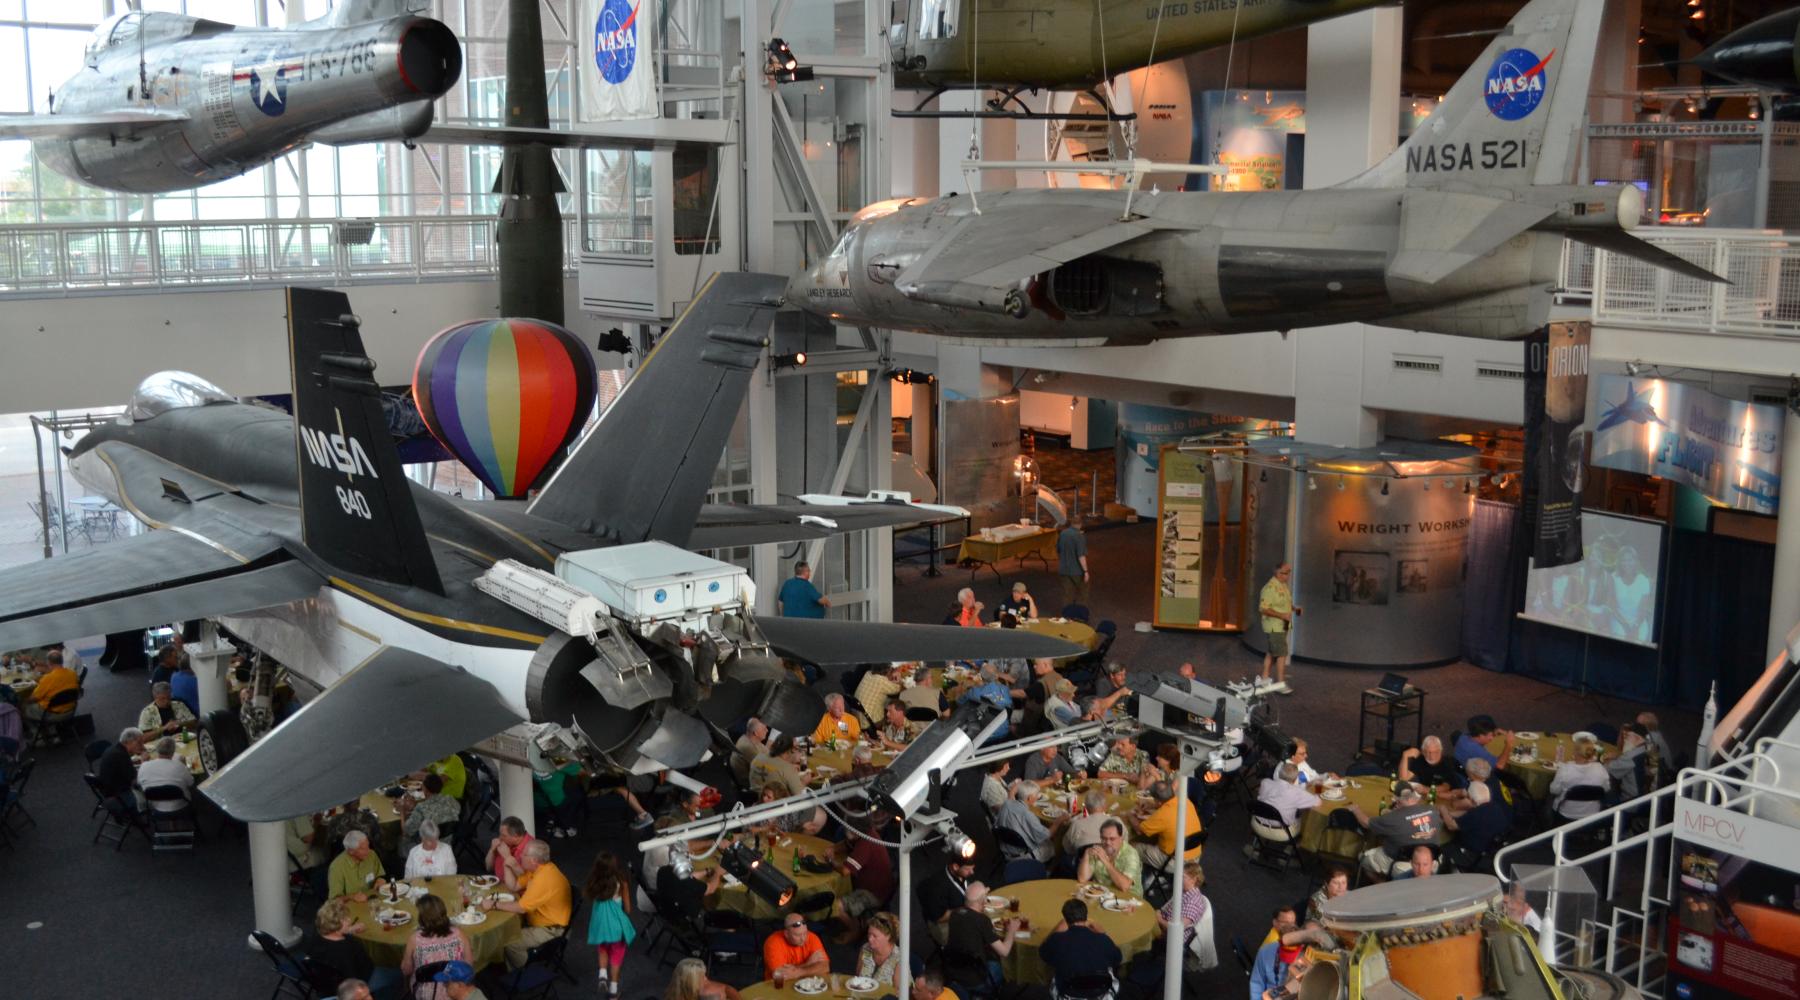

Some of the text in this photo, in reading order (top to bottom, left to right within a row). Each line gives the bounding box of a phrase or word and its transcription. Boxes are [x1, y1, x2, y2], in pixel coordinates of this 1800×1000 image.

[1146, 3, 1188, 20] UNITED
[1194, 0, 1237, 14] STATES
[598, 28, 635, 52] NASA
[1487, 75, 1542, 95] NASA
[1405, 140, 1526, 173] NASA 521
[1551, 344, 1588, 378] ORION
[300, 425, 379, 479] NASA
[335, 485, 372, 520] 840
[1338, 520, 1412, 534] WRIGHT
[1684, 810, 1746, 843] MPCV
